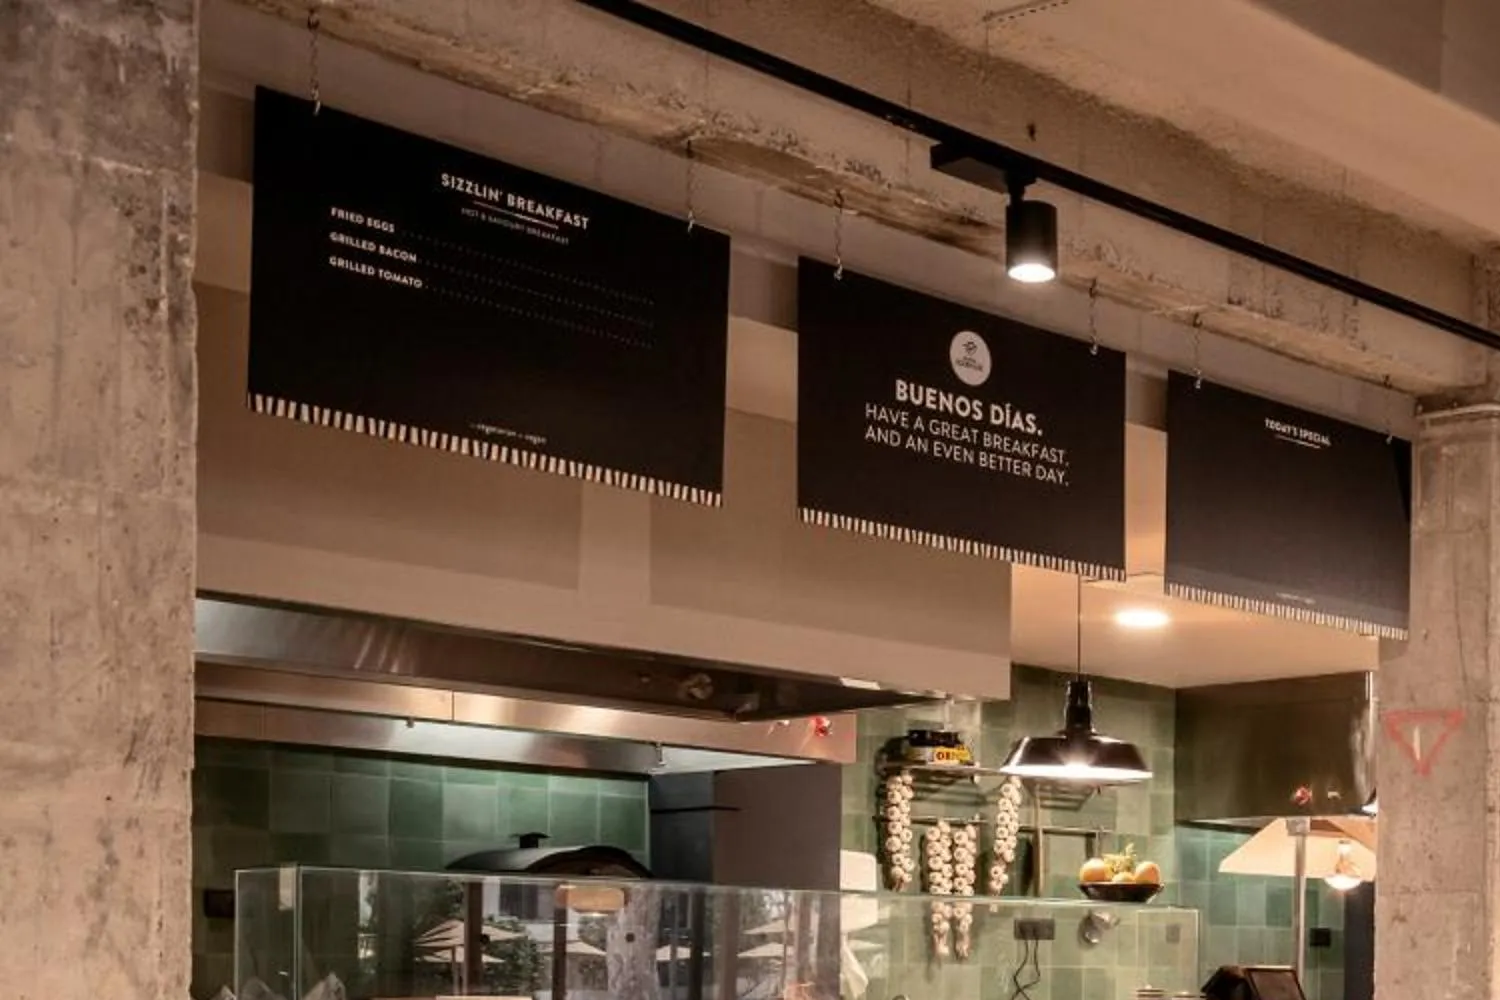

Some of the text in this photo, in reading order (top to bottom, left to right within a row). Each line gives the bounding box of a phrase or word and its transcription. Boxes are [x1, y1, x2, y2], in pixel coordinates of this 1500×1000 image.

[331, 207, 395, 233] FRIED EGGS
[441, 172, 590, 230] SIZZLIN' BREAKFAST
[329, 231, 417, 263] GRILLED BACON
[329, 256, 423, 288] GRILLED TOMATO
[865, 402, 909, 429] HAVE
[913, 415, 925, 433] A
[929, 419, 979, 445] GREAT
[895, 379, 1043, 436] BUENOS DÍAS.
[865, 425, 1070, 487] AND AN EVEN BETTER DAY.
